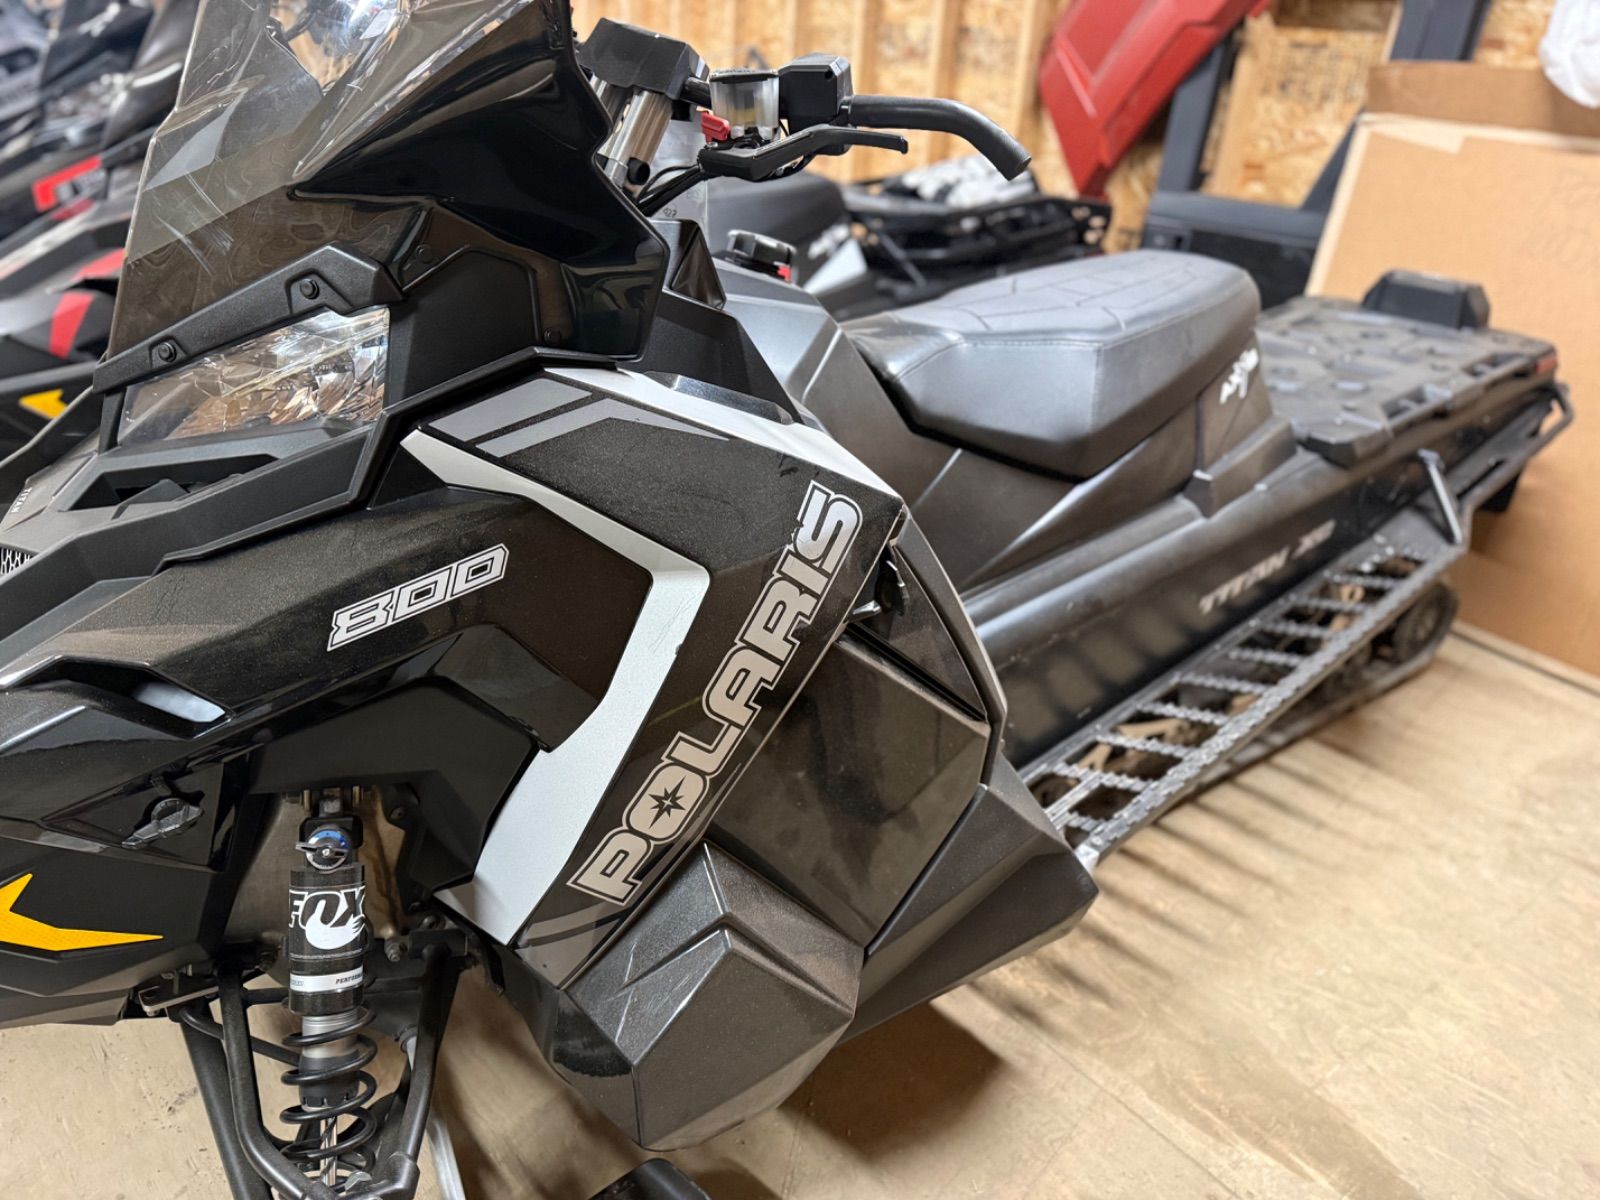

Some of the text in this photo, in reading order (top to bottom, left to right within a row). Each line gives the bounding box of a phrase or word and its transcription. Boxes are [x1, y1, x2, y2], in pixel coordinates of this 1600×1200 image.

[10, 487, 33, 513] TITAN
[327, 543, 509, 652] 800
[567, 480, 863, 905] POLARIS
[288, 885, 365, 929] FOX
